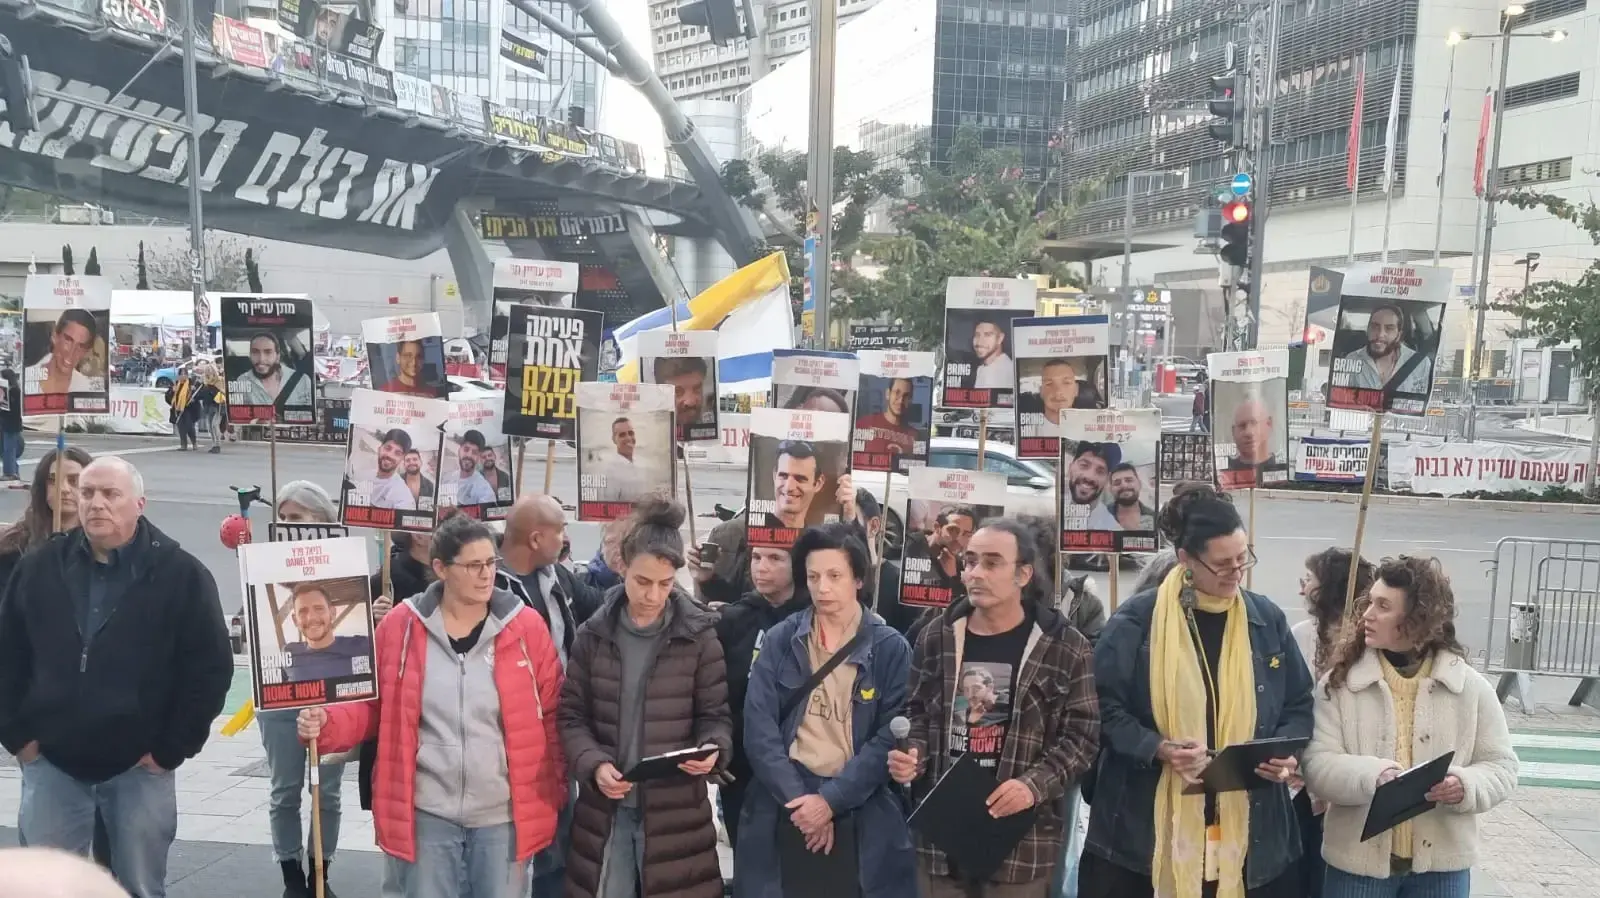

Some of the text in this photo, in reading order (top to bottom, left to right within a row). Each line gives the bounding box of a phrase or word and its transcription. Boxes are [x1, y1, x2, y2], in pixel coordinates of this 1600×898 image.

[235, 127, 369, 220] כולם
[358, 159, 440, 230] את
[237, 302, 296, 316] מתן עדיין חי
[526, 315, 585, 340] פעימה
[524, 335, 584, 369] אחת
[947, 363, 971, 375] BRING
[1333, 358, 1362, 373] BRING
[947, 375, 962, 388] HIM
[1332, 372, 1351, 386] HIM
[228, 380, 252, 393] BRING
[229, 393, 244, 405] HIM
[1020, 413, 1044, 425] BRING
[1306, 445, 1369, 458] מחזירים אותם
[1339, 460, 1368, 472] הביתה
[1414, 457, 1449, 477] בבית
[1454, 457, 1474, 477] לא
[1477, 458, 1516, 480] עדיין
[1520, 461, 1570, 484] שאתם
[581, 474, 607, 488] BRING
[749, 499, 776, 513] BRING
[1063, 504, 1091, 517] BRING
[748, 512, 766, 526] HIM
[748, 527, 800, 542] HOME NOW!
[286, 554, 330, 568] DANIEL PERETZ
[905, 557, 932, 572] BRING
[302, 567, 316, 576] (22)
[903, 571, 921, 584] HIM
[903, 585, 952, 602] HOME NOW!
[261, 651, 293, 668] BRING
[261, 668, 283, 684] HIM
[263, 679, 326, 702] HOME NOW!
[949, 734, 1002, 753] OME NOW!
